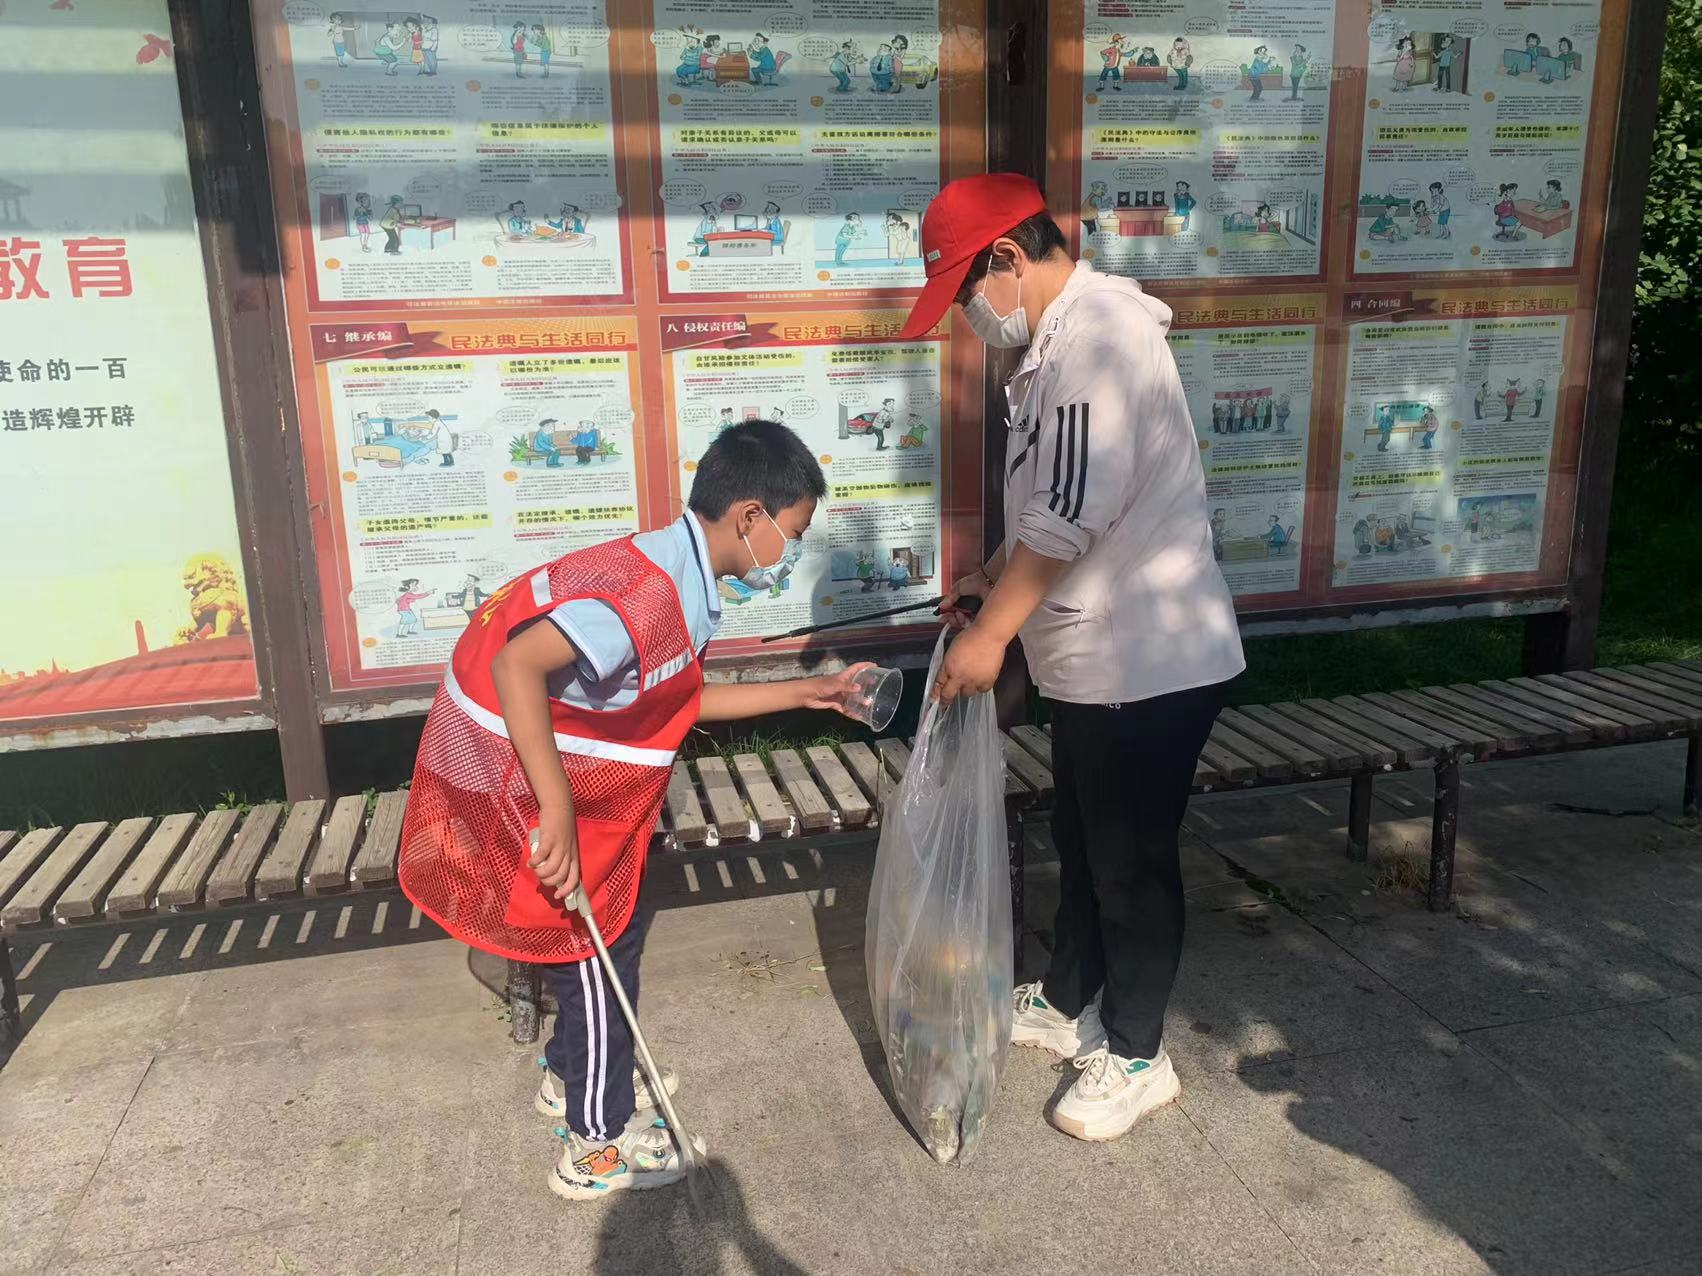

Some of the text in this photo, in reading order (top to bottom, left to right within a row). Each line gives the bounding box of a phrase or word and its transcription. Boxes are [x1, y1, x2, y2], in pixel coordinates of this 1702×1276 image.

[0, 236, 133, 300] 教育
[1367, 297, 1401, 309] 合同编
[1441, 297, 1569, 315] 民法典与生活同行
[1176, 305, 1317, 325] 民法典与生活同行
[322, 329, 393, 344] 七 继承编
[666, 320, 747, 334] 八 侵权责任编
[783, 322, 941, 341] 民法典与生活
[449, 330, 628, 351] 民法典与生活同行
[0, 357, 128, 383] 使命的一百
[2, 404, 136, 432] 造辉煌开辟
